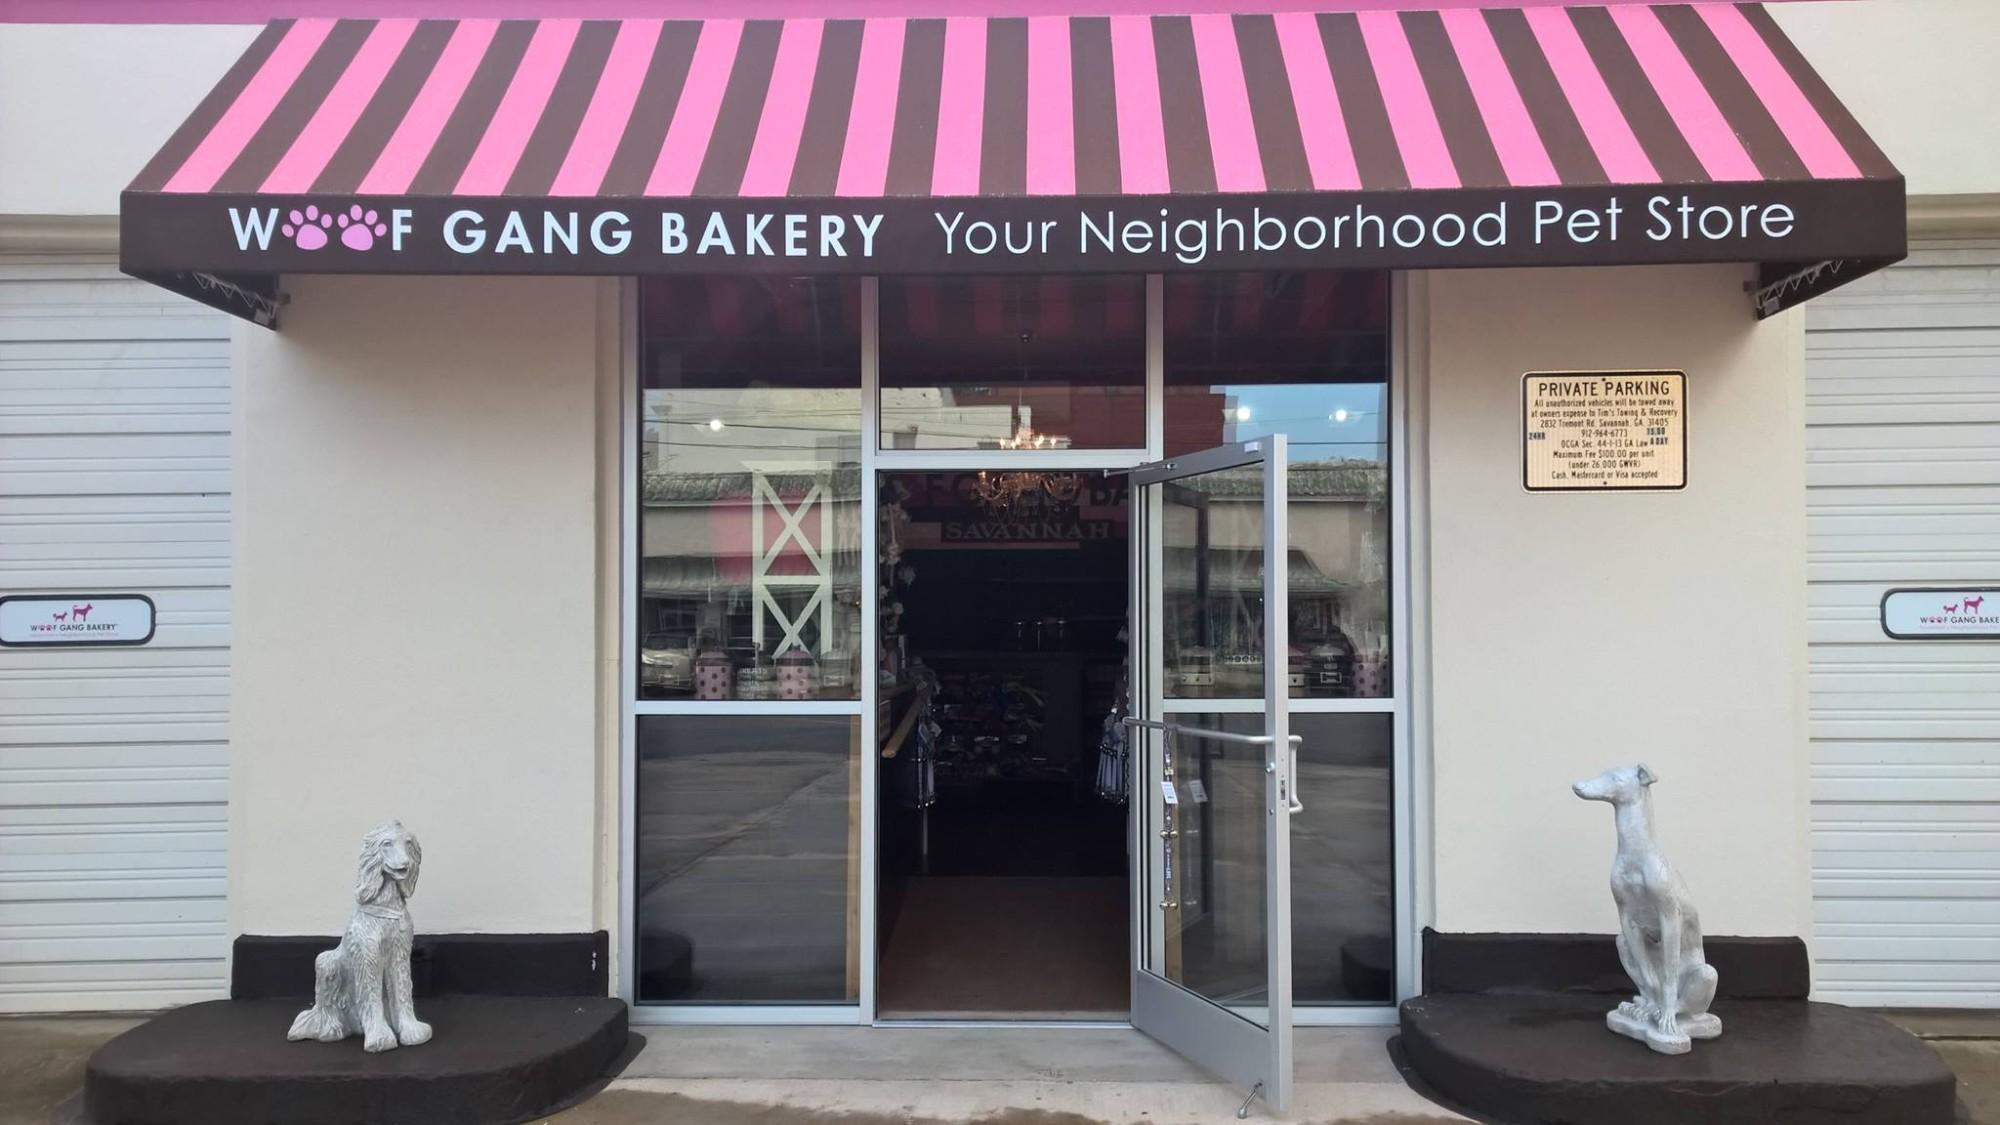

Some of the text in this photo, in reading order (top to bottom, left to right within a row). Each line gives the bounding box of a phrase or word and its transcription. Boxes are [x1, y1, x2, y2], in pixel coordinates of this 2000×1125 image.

[443, 209, 632, 256] GANG
[661, 211, 885, 258] BAKERY
[935, 211, 1058, 256] Your
[1080, 202, 1508, 264] Neighborhood
[1535, 196, 1623, 244] Pet
[1645, 194, 1795, 242] Store
[1539, 381, 1669, 396] PRIVATE PARKING
[1534, 399, 1543, 407] All
[1546, 399, 1586, 407] unauthorized
[1588, 399, 1613, 407] vehicles
[1531, 410, 1538, 418] at
[1598, 408, 1614, 417] Tim's
[1617, 408, 1638, 418] Towing
[1641, 408, 1646, 416] &
[1649, 408, 1678, 417] Recovery
[1540, 420, 1557, 428] 2832
[1559, 419, 1584, 428] Tremont
[1648, 418, 1669, 427] 31405
[1581, 429, 1628, 438] 912-964-6773
[1561, 440, 1579, 448] OCGA
[1597, 439, 1622, 448] 44-1-13
[1624, 439, 1634, 448] GA
[1636, 439, 1648, 447] Law
[1656, 437, 1668, 445] DAY
[1553, 450, 1583, 458] Maximum
[1585, 450, 1596, 458] Fee
[1598, 449, 1627, 459] $100.00
[1571, 470, 1605, 479] Mastercard
[1615, 470, 1628, 479] Visa
[1631, 470, 1658, 479] accepted
[945, 521, 1110, 539] SAVANNAH
[1950, 616, 1977, 624] GANG
[59, 624, 85, 632] GANG
[86, 623, 115, 631] BAKERY
